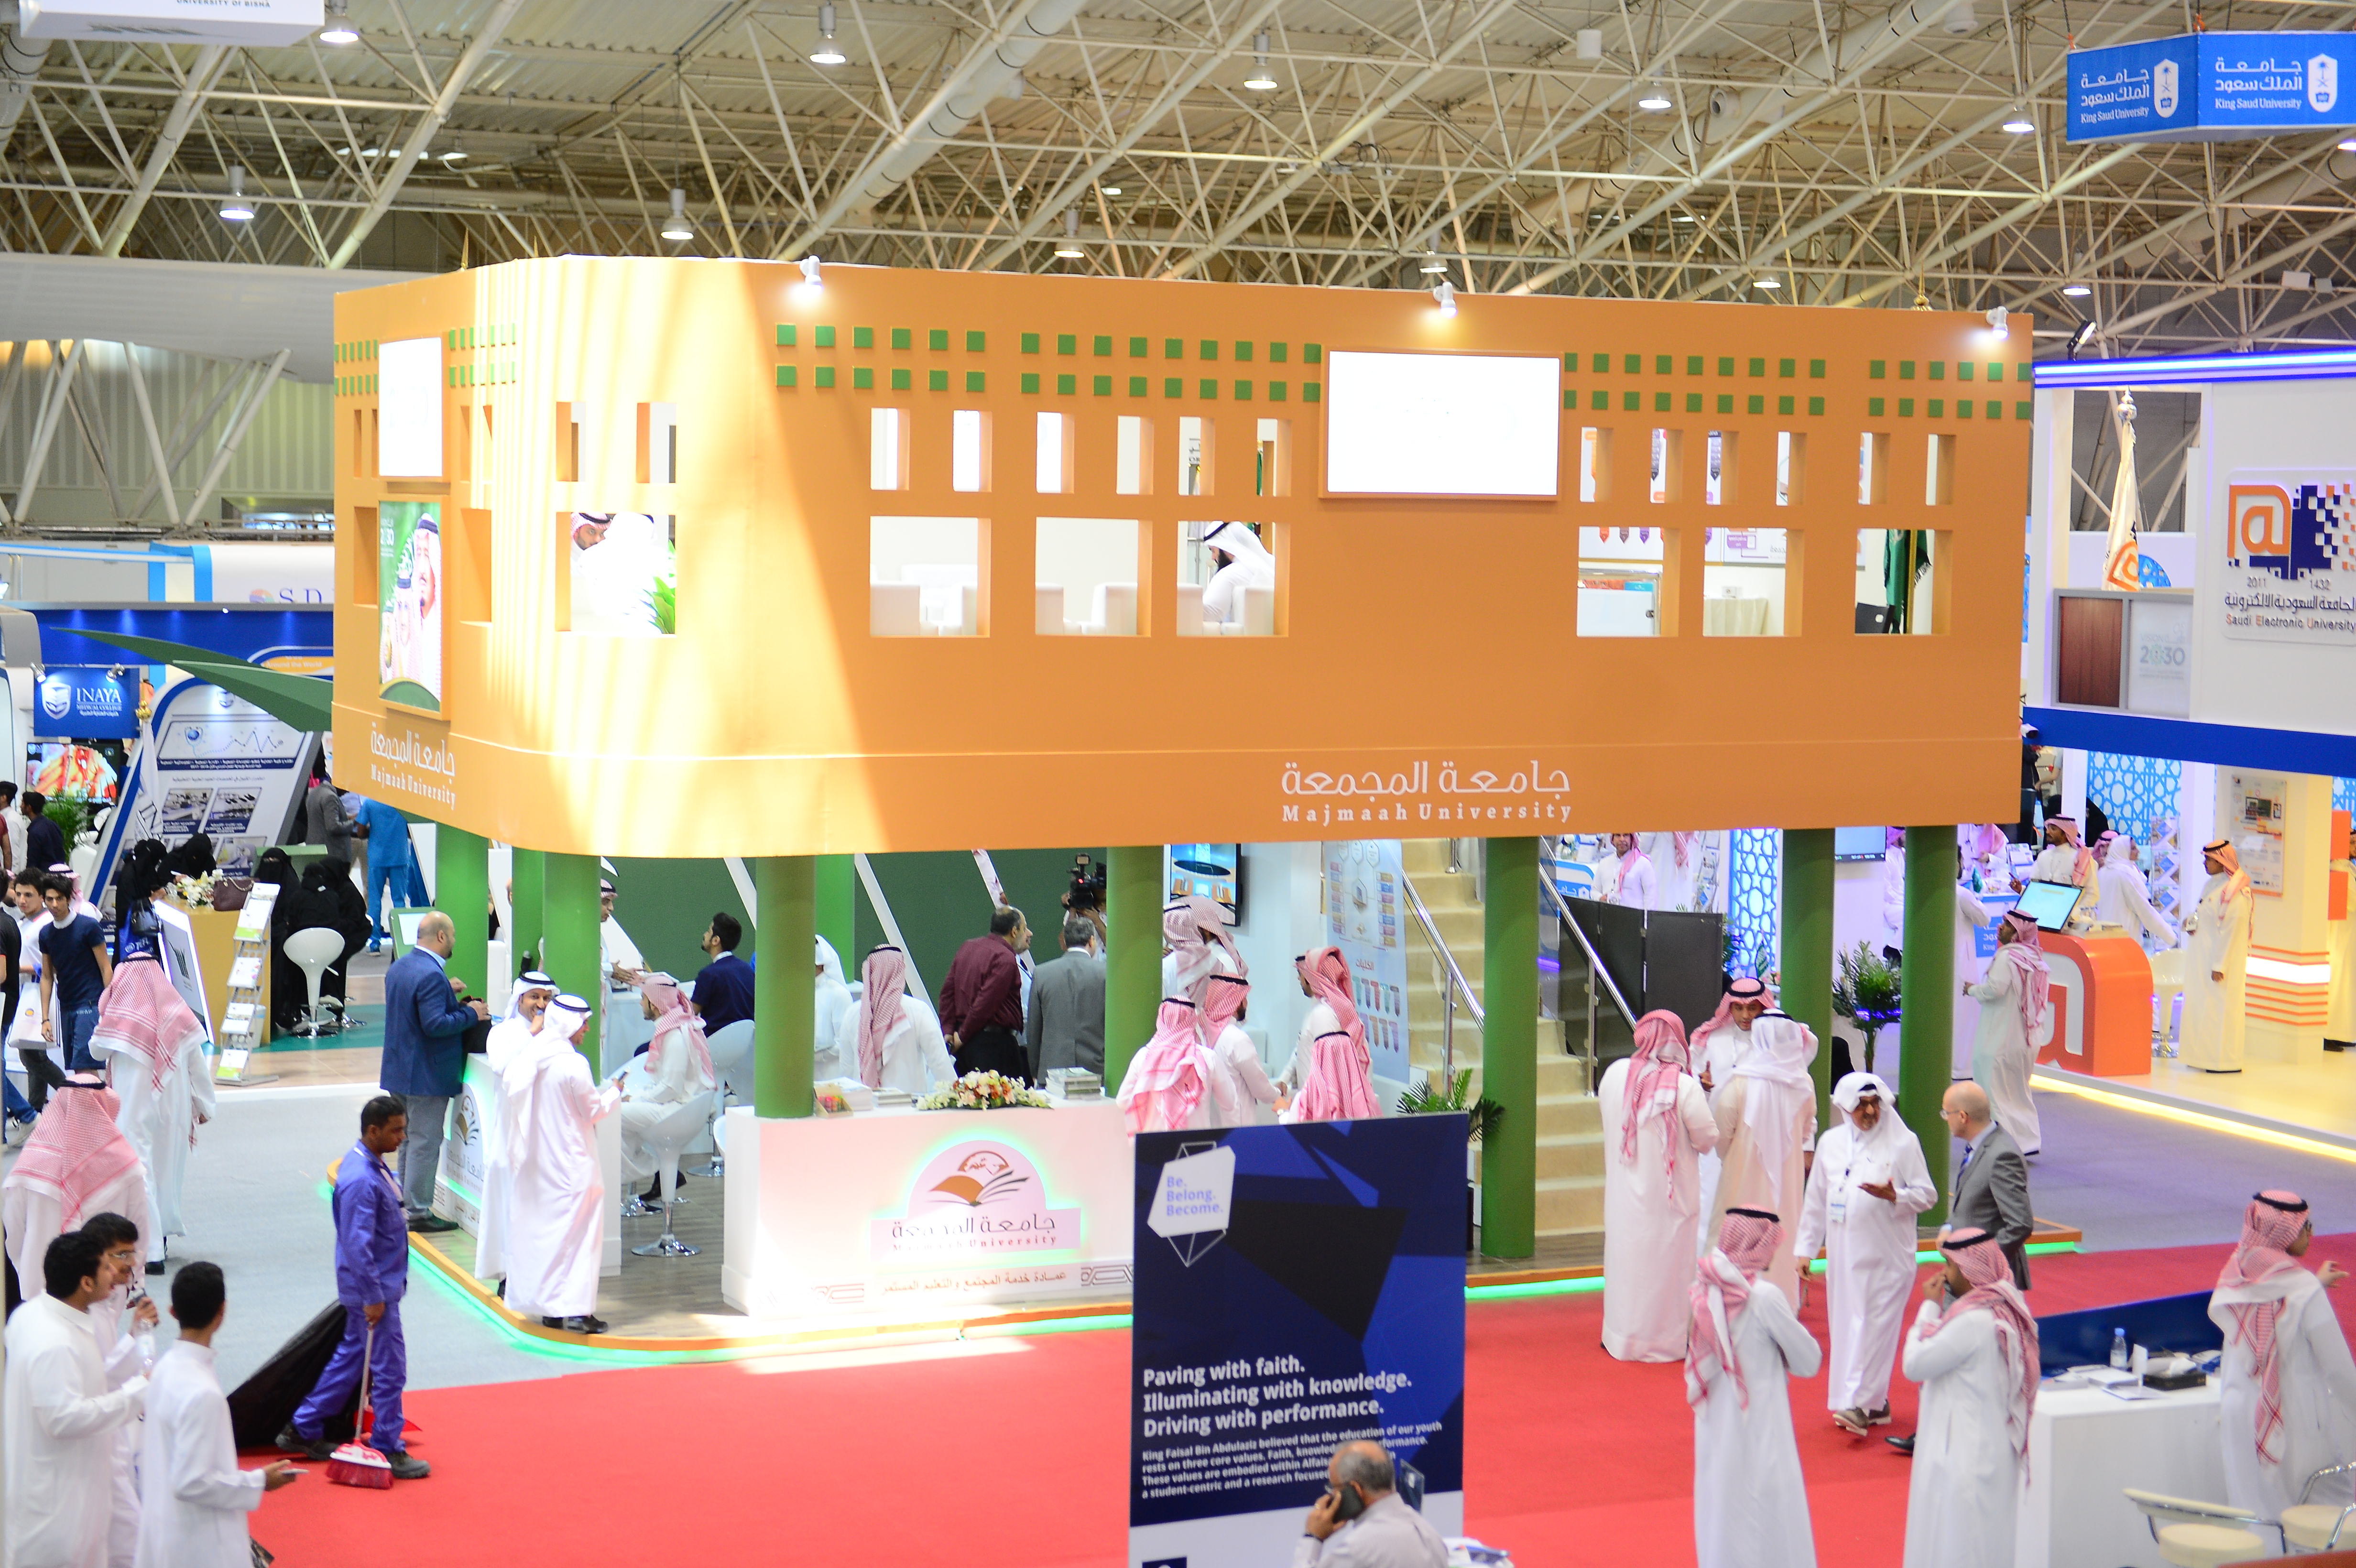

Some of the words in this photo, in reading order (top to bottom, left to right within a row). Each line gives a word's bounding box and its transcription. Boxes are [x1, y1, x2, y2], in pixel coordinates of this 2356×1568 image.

[2215, 56, 2302, 75] جامعة
[2081, 68, 2150, 88] جامعة
[2215, 79, 2258, 94] سعود
[2259, 76, 2302, 91] الملك
[2081, 92, 2114, 108] سعود
[2115, 84, 2150, 102] الملك
[2215, 98, 2236, 110] King
[2236, 98, 2258, 109] Saud
[2259, 98, 2302, 110] University
[2081, 112, 2097, 124] King
[2097, 110, 2114, 121] Saud
[2115, 106, 2149, 119] University
[2247, 577, 2266, 588] 2011
[2309, 579, 2331, 591] 1432
[2274, 594, 2318, 614] السعودية
[2319, 595, 2356, 615] لجامعة
[2226, 614, 2251, 626] Saudi
[2256, 615, 2303, 628] Electronic
[2307, 617, 2356, 633] University
[76, 687, 121, 702] INAYA
[371, 721, 412, 769] المجمعة
[414, 732, 456, 785] جامعة
[371, 763, 406, 791] Majmaah
[408, 774, 456, 811] University
[1281, 760, 1428, 803] المجمعة
[1438, 760, 1571, 800] جامعة
[1282, 803, 1407, 827] Majmaah
[1419, 801, 1571, 823] University
[1167, 1176, 1186, 1187] Be.
[1167, 1189, 1216, 1202] Belong.
[1167, 1204, 1223, 1216] Become.
[980, 1213, 1056, 1234] جامعة
[970, 1235, 1057, 1248] University
[1144, 1365, 1206, 1387] Paving
[1210, 1359, 1251, 1381] with
[1256, 1354, 1305, 1377] faith.
[1144, 1384, 1259, 1413] Illuminating
[1263, 1378, 1304, 1400] with
[1309, 1370, 1412, 1394] knowledge.
[1144, 1414, 1211, 1437] Driving
[1215, 1407, 1256, 1430] with
[1261, 1399, 1384, 1430] performance.
[1143, 1450, 1164, 1462] King
[1166, 1445, 1193, 1459] Faisal
[1195, 1444, 1211, 1456] Bin
[1212, 1439, 1257, 1454] Abdulaziz
[1259, 1434, 1298, 1449] believed
[1300, 1433, 1320, 1445] that
[1321, 1431, 1338, 1442] the
[1339, 1426, 1385, 1441] education
[1386, 1424, 1397, 1436] of
[1398, 1425, 1414, 1435] our
[1416, 1421, 1442, 1435] youth
[1143, 1462, 1166, 1474] rests
[1168, 1461, 1180, 1471] on
[1182, 1458, 1208, 1470] three
[1210, 1456, 1231, 1467] core
[1268, 1448, 1294, 1460] Faith,
[1296, 1443, 1336, 1457] knowled
[1143, 1474, 1170, 1487] These
[1172, 1471, 1203, 1483] values
[1205, 1470, 1220, 1480] are
[1222, 1463, 1269, 1478] embodied
[1270, 1459, 1300, 1472] within
[1142, 1490, 1148, 1499] a
[1150, 1479, 1222, 1499] student-centric
[1224, 1478, 1242, 1489] and
[1244, 1478, 1250, 1488] a
[1252, 1472, 1292, 1487] research
